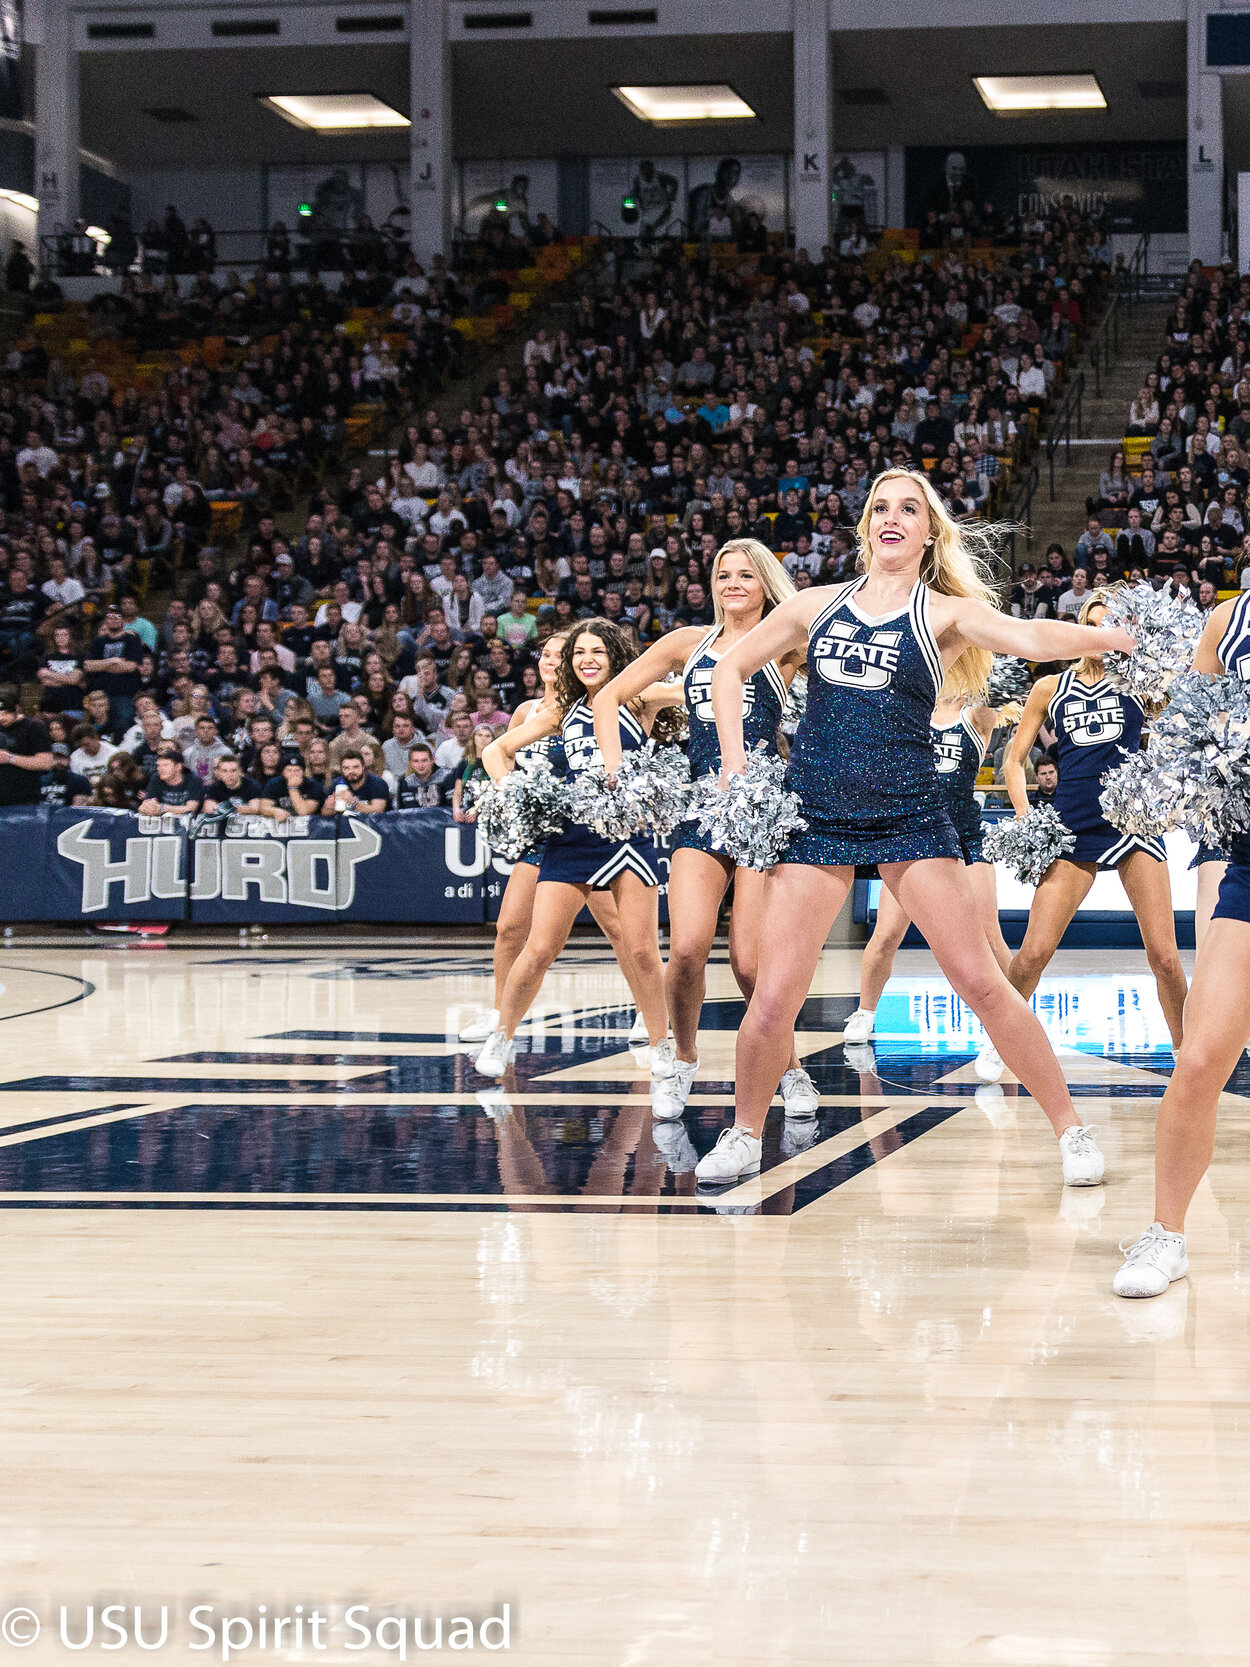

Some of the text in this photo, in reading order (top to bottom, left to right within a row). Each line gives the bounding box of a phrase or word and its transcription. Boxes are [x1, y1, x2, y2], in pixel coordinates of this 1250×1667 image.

[804, 153, 819, 171] K
[1199, 146, 1212, 163] L
[420, 162, 432, 180] J
[1119, 151, 1189, 181] STA
[42, 173, 57, 190] H
[814, 637, 901, 672] STATE
[688, 683, 756, 705] STE
[1063, 708, 1126, 733] STATE
[564, 735, 601, 758] STA
[58, 818, 382, 913] HURD
